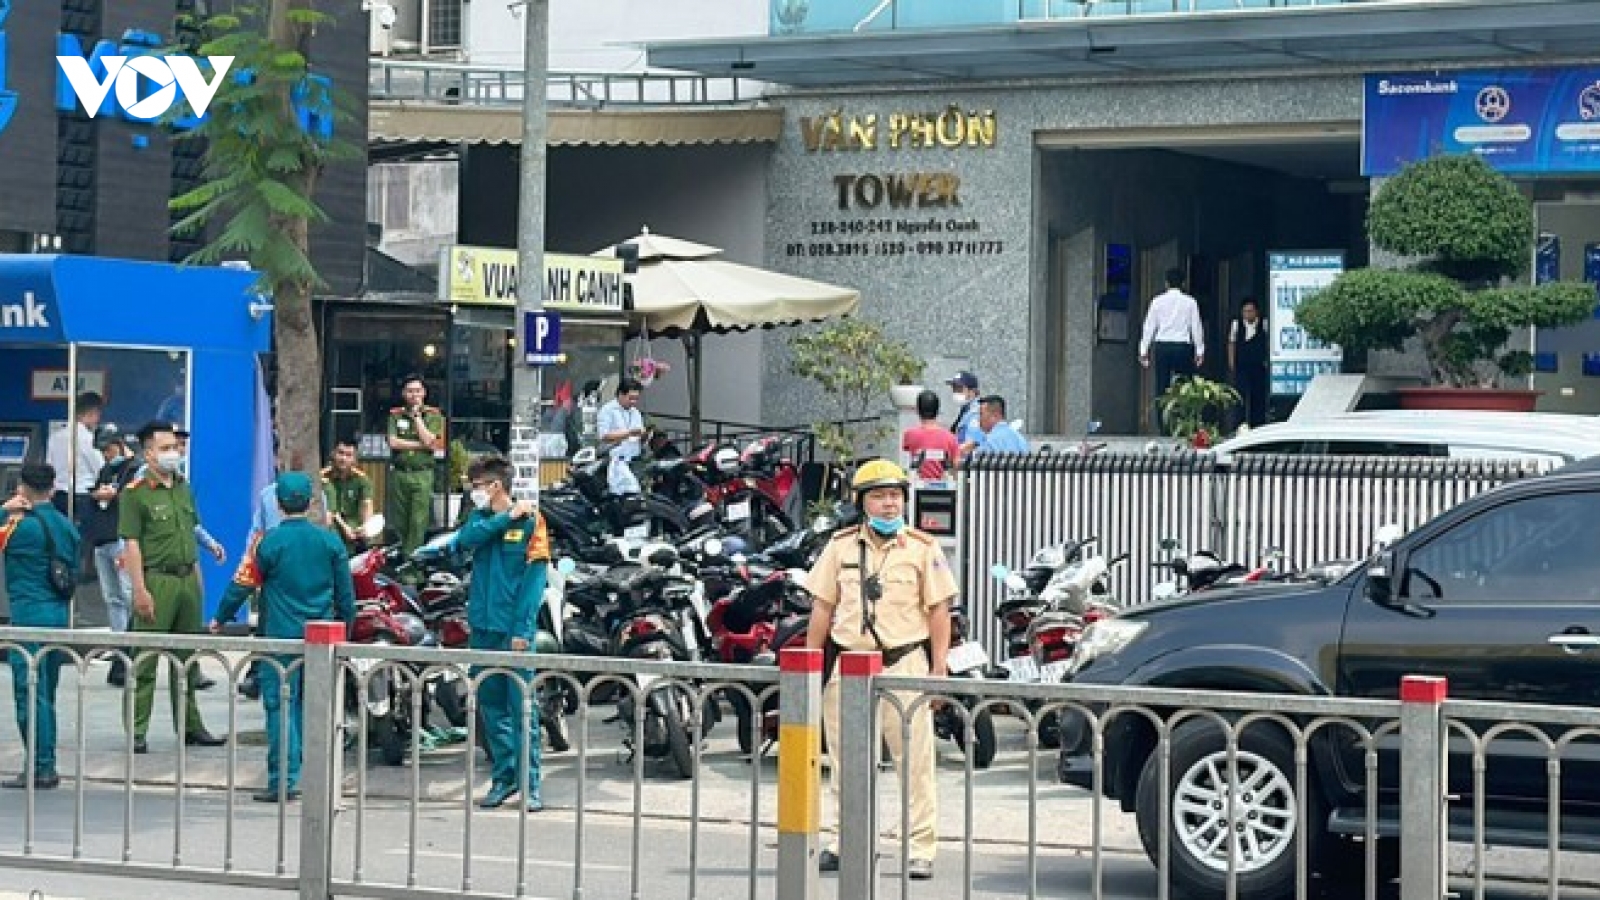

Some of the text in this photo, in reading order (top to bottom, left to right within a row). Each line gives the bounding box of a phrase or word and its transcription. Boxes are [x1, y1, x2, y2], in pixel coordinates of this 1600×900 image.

[1378, 79, 1458, 95] Sacombank
[833, 171, 962, 211] TOWER
[0, 291, 50, 328] nk
[535, 316, 549, 351] P
